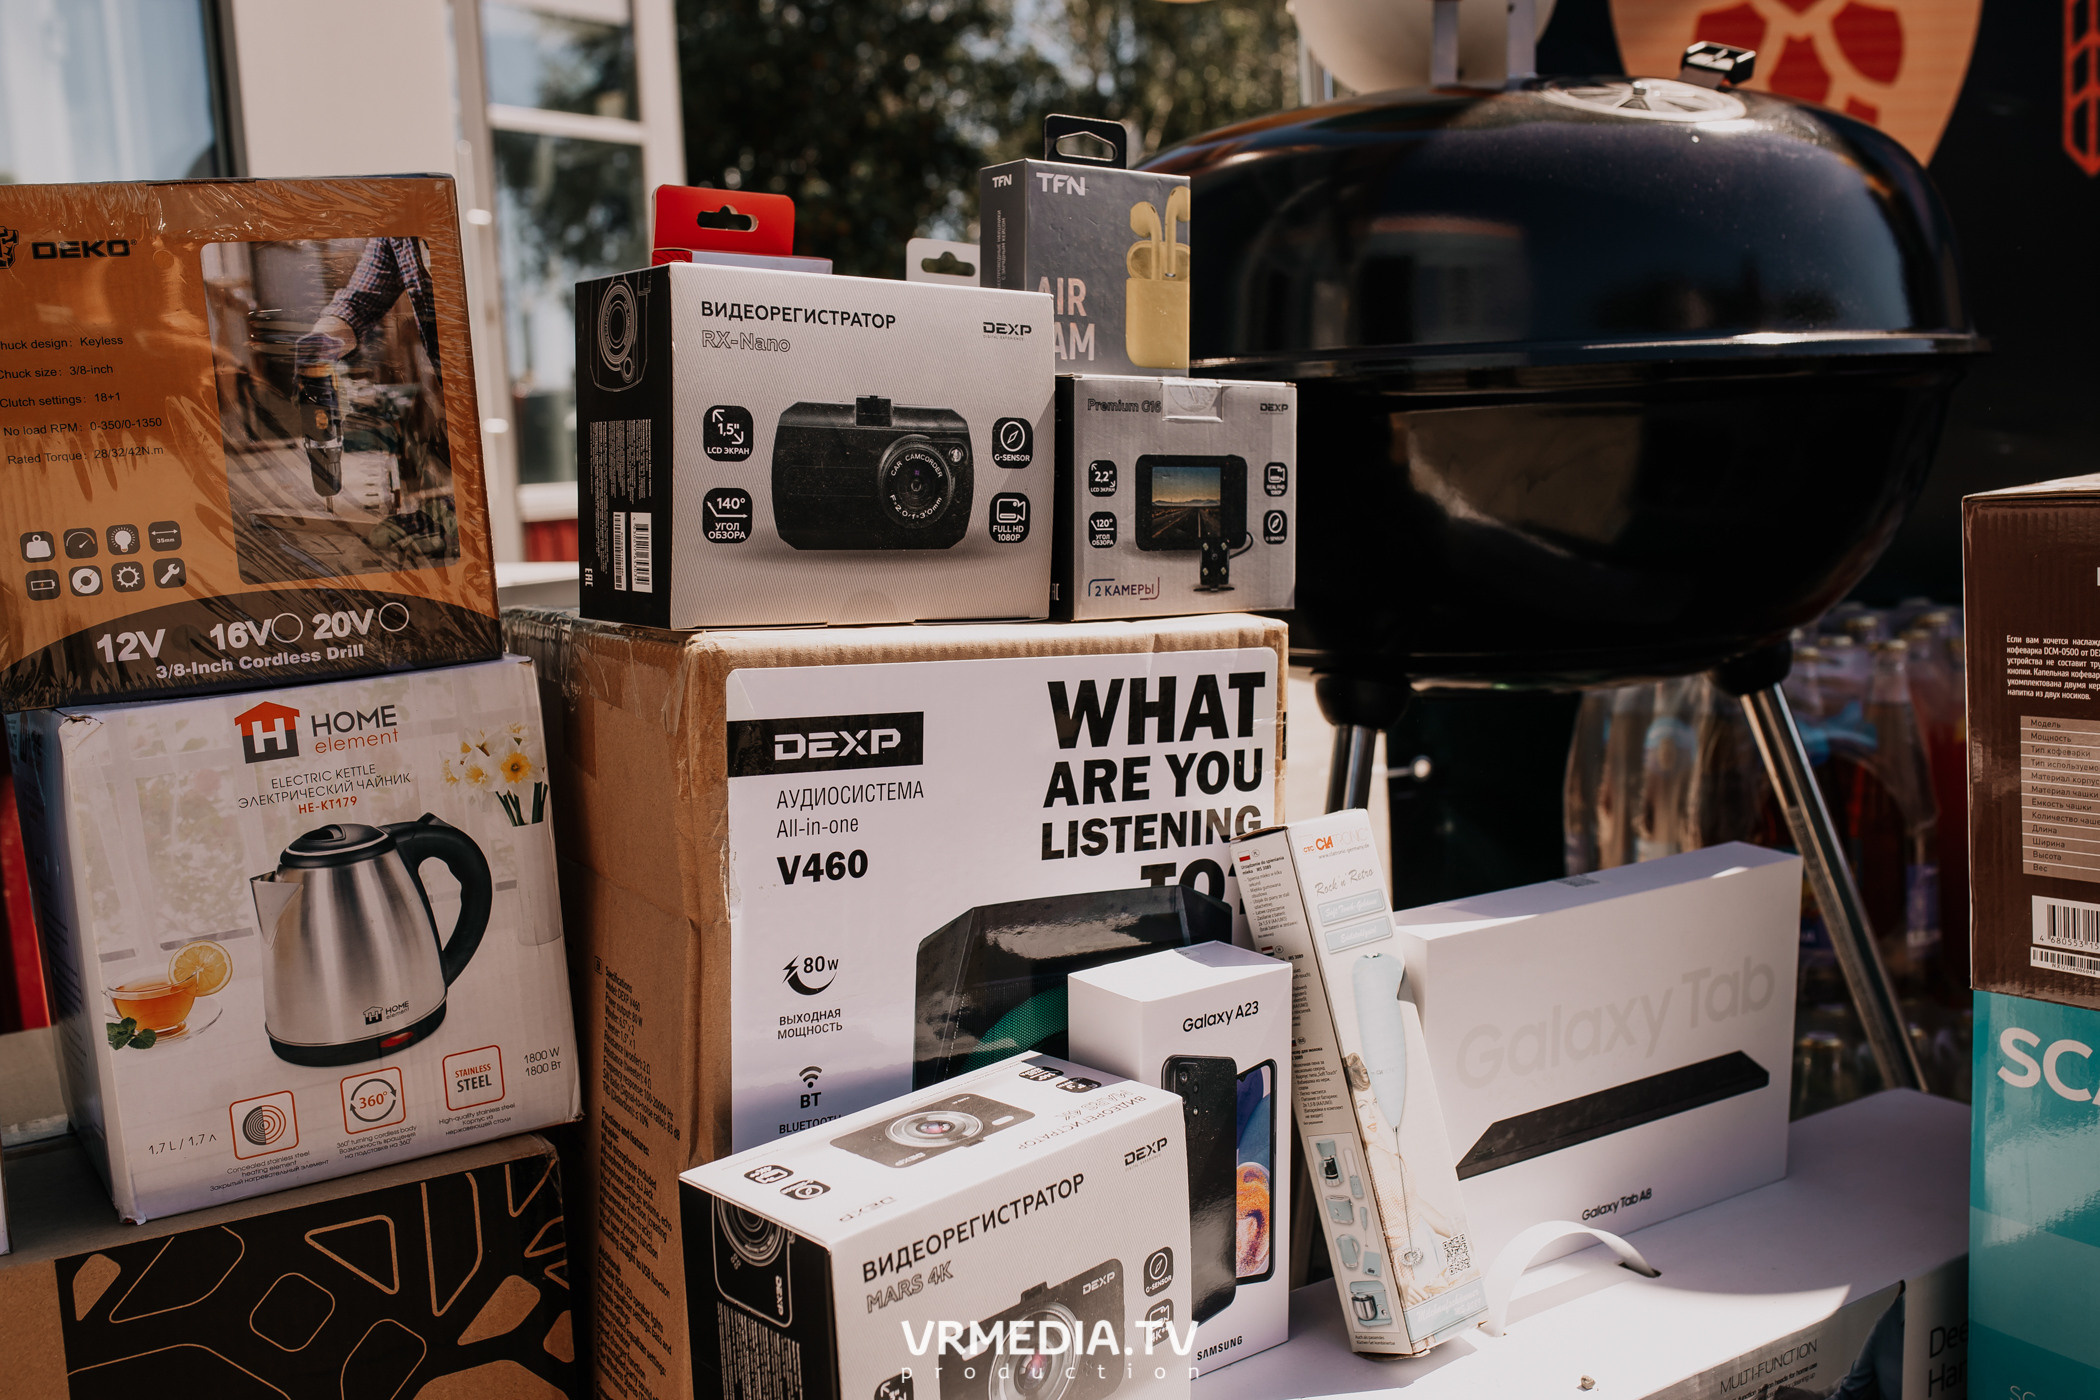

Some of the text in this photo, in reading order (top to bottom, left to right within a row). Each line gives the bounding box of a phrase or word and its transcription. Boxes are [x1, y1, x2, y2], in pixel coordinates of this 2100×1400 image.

[992, 174, 1012, 189] TFN
[1036, 172, 1086, 196] TFN
[32, 239, 131, 260] DEKO
[701, 300, 896, 329] ВИДЕОРЕГИСТРАТОР
[983, 322, 1031, 335] DEXP
[0, 336, 124, 350] huck Keyless
[701, 330, 791, 353] RX-Nano
[1054, 322, 1095, 362] AM
[69, 364, 113, 375] 3/8-inch
[0, 392, 120, 408] Clutch 18+1
[1088, 399, 1162, 413] Premium G16
[1260, 403, 1288, 411] DEXP
[4, 417, 162, 436] No load 0-350/0-1350
[7, 446, 163, 464] Rated 28/32/42N.m
[707, 446, 749, 455] LCD ЭКРАН
[994, 453, 1030, 462] G-SENSOR
[890, 454, 943, 478] CAR CAMCORDER
[717, 497, 746, 510] 140°
[714, 523, 740, 532] УГОЛ
[993, 525, 1024, 533] FULL HD
[1096, 518, 1113, 528] 120°
[708, 531, 746, 540] ОБЗОРА
[997, 533, 1020, 542] 1080P
[1095, 584, 1154, 597] 2 КАМЕРЫ
[97, 608, 374, 663] 12V 16V 20V
[2006, 635, 2022, 643] Если
[2006, 646, 2042, 656] кофеварка
[2043, 647, 2079, 656] DCM-0500
[155, 644, 364, 679] 3/8-Inch Cordless Drill
[2006, 657, 2087, 668] устройства составит
[2033, 668, 2069, 677] Капельная
[2007, 678, 2086, 691] укомплектована двумя
[2007, 689, 2091, 700] напитка двух носиков.
[1048, 671, 1266, 750] WHAT
[311, 705, 397, 737] HOME
[2030, 719, 2061, 728] Модель
[315, 729, 399, 754] element
[774, 728, 901, 761] DEXP
[2030, 732, 2072, 743] Мощность
[2031, 745, 2091, 757] Тип кофеварки
[2031, 758, 2045, 767] Тип
[271, 764, 376, 789] ELECTRIC KETTLE
[1042, 748, 1264, 808] ARE YOU
[2031, 772, 2070, 783] Материал
[238, 772, 411, 809] ЭЛЕКТРИЧЕСКИЙ ЧАЙНИК
[776, 780, 924, 810] АУДИОСИСТЕМА
[2031, 786, 2099, 799] Материал чашки
[298, 796, 358, 814] HE-KT179
[2066, 803, 2092, 811] чашки
[2031, 811, 2078, 823] Количество
[776, 814, 859, 839] All-in-one
[1041, 805, 1262, 860] LISTENING
[2032, 824, 2057, 834] Длина
[2033, 838, 2065, 848] Ширина
[2033, 851, 2062, 861] Высота
[776, 848, 868, 885] V460
[2033, 864, 2048, 872] Вес
[1315, 868, 1374, 896] Rock Retro
[385, 1000, 409, 1015] HOME
[1182, 1000, 1259, 1033] Galaxy A23
[779, 1008, 841, 1026] ВЫХОДНАЯ
[1456, 956, 1775, 1090] Galaxy Tab
[777, 1022, 843, 1040] МОЩНОСТЬ
[523, 1047, 560, 1064] 1800 W
[455, 1063, 491, 1078] STAINLESS
[525, 1061, 561, 1077] 1800 Вт
[1997, 1027, 2100, 1106] SC
[457, 1074, 492, 1093] STEEL
[359, 1091, 388, 1109] 360°
[800, 1092, 822, 1109] BT
[439, 1107, 500, 1125] High-quality stainless
[462, 1116, 486, 1126] Корпус
[374, 1125, 417, 1139] cordless body
[445, 1117, 511, 1136] нержавеющей стали
[339, 1132, 416, 1154] Возможность вращения
[1123, 1137, 1168, 1167] DEXP
[226, 1151, 311, 1175] Concealed stainless steel
[241, 1160, 297, 1178] heating element
[209, 1159, 329, 1192] Закрытый нагревательный элемент
[1582, 1188, 1653, 1221] Galaxy Tab A8
[862, 1173, 1084, 1283] ВИДЕОРЕГИСТРАТОР
[866, 1260, 953, 1314] MARS 4K
[1082, 1271, 1115, 1295] DEXP
[1145, 1275, 1171, 1294] G-SENSOR
[775, 1275, 784, 1316] DEXP
[1197, 1335, 1243, 1361] SAMSUNG
[1720, 1338, 1818, 1395] MULTI-FUNCTION
